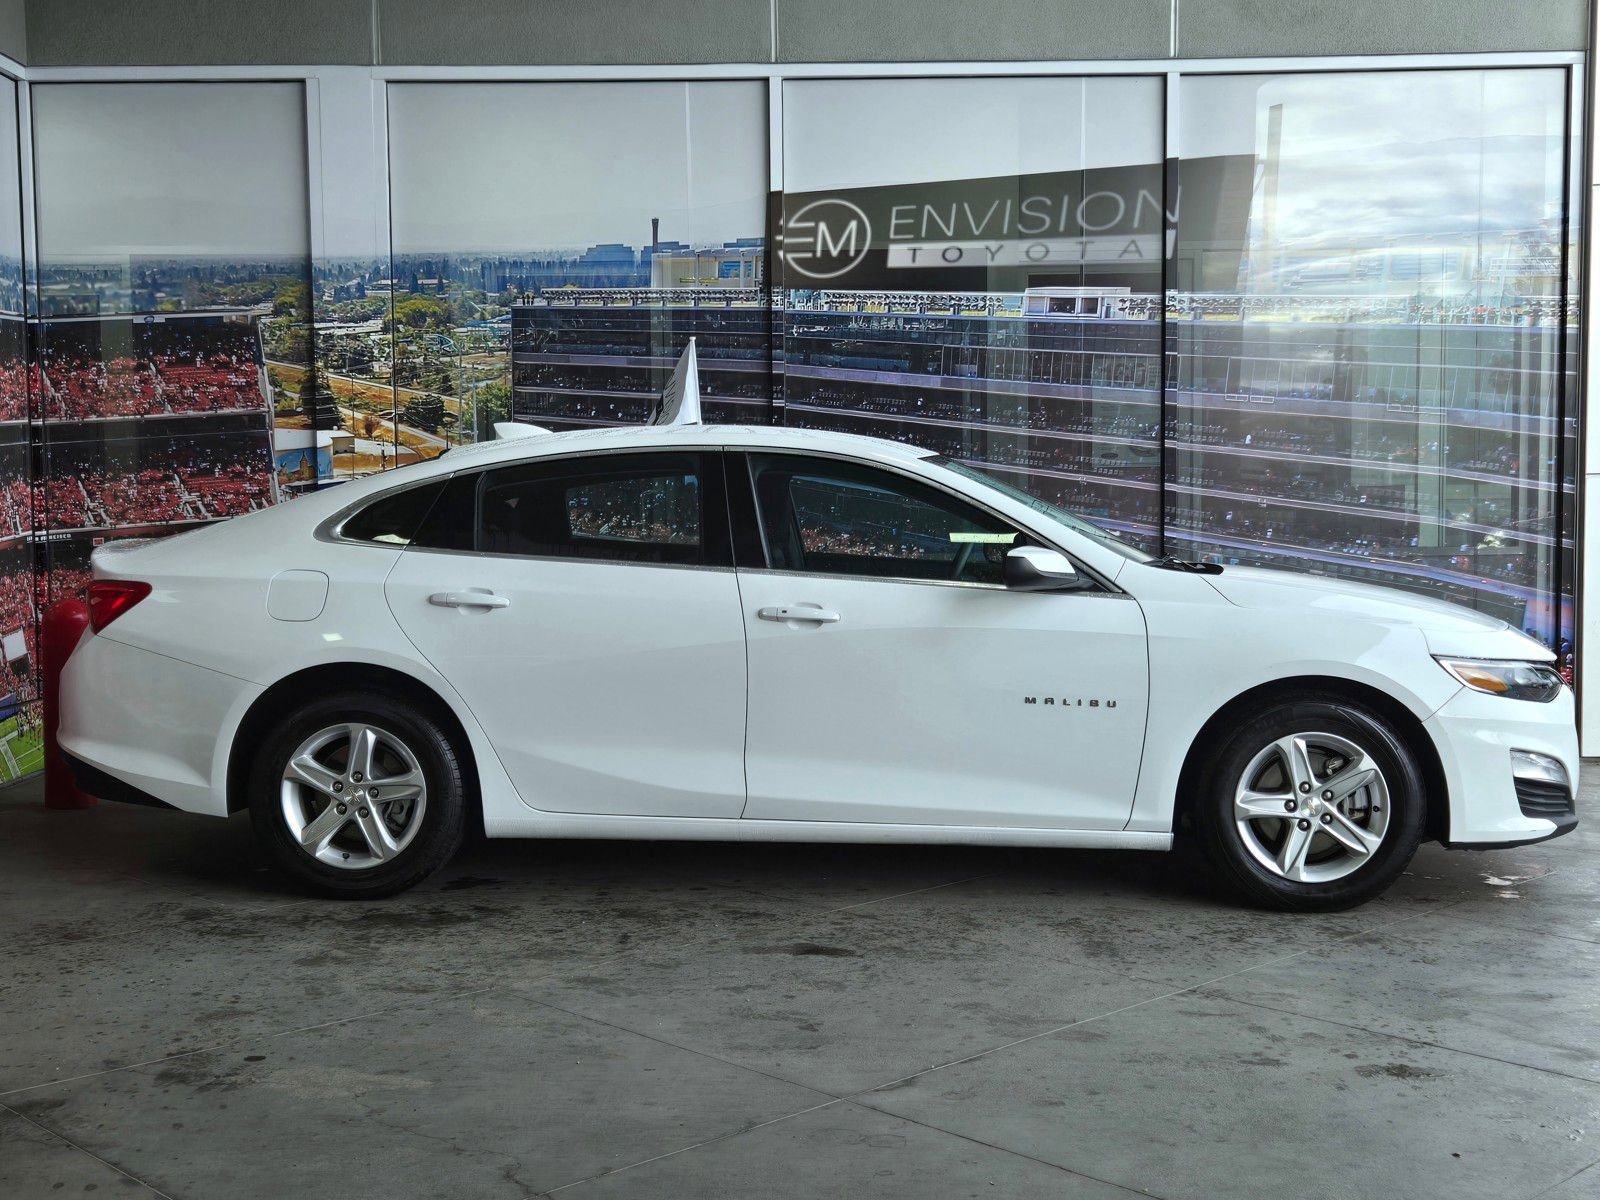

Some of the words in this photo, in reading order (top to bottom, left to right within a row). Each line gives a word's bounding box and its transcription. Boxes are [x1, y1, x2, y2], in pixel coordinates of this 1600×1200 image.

[888, 185, 1181, 239] ENVISION
[907, 239, 1144, 263] TOYOTA
[1024, 697, 1117, 708] MALIBU
